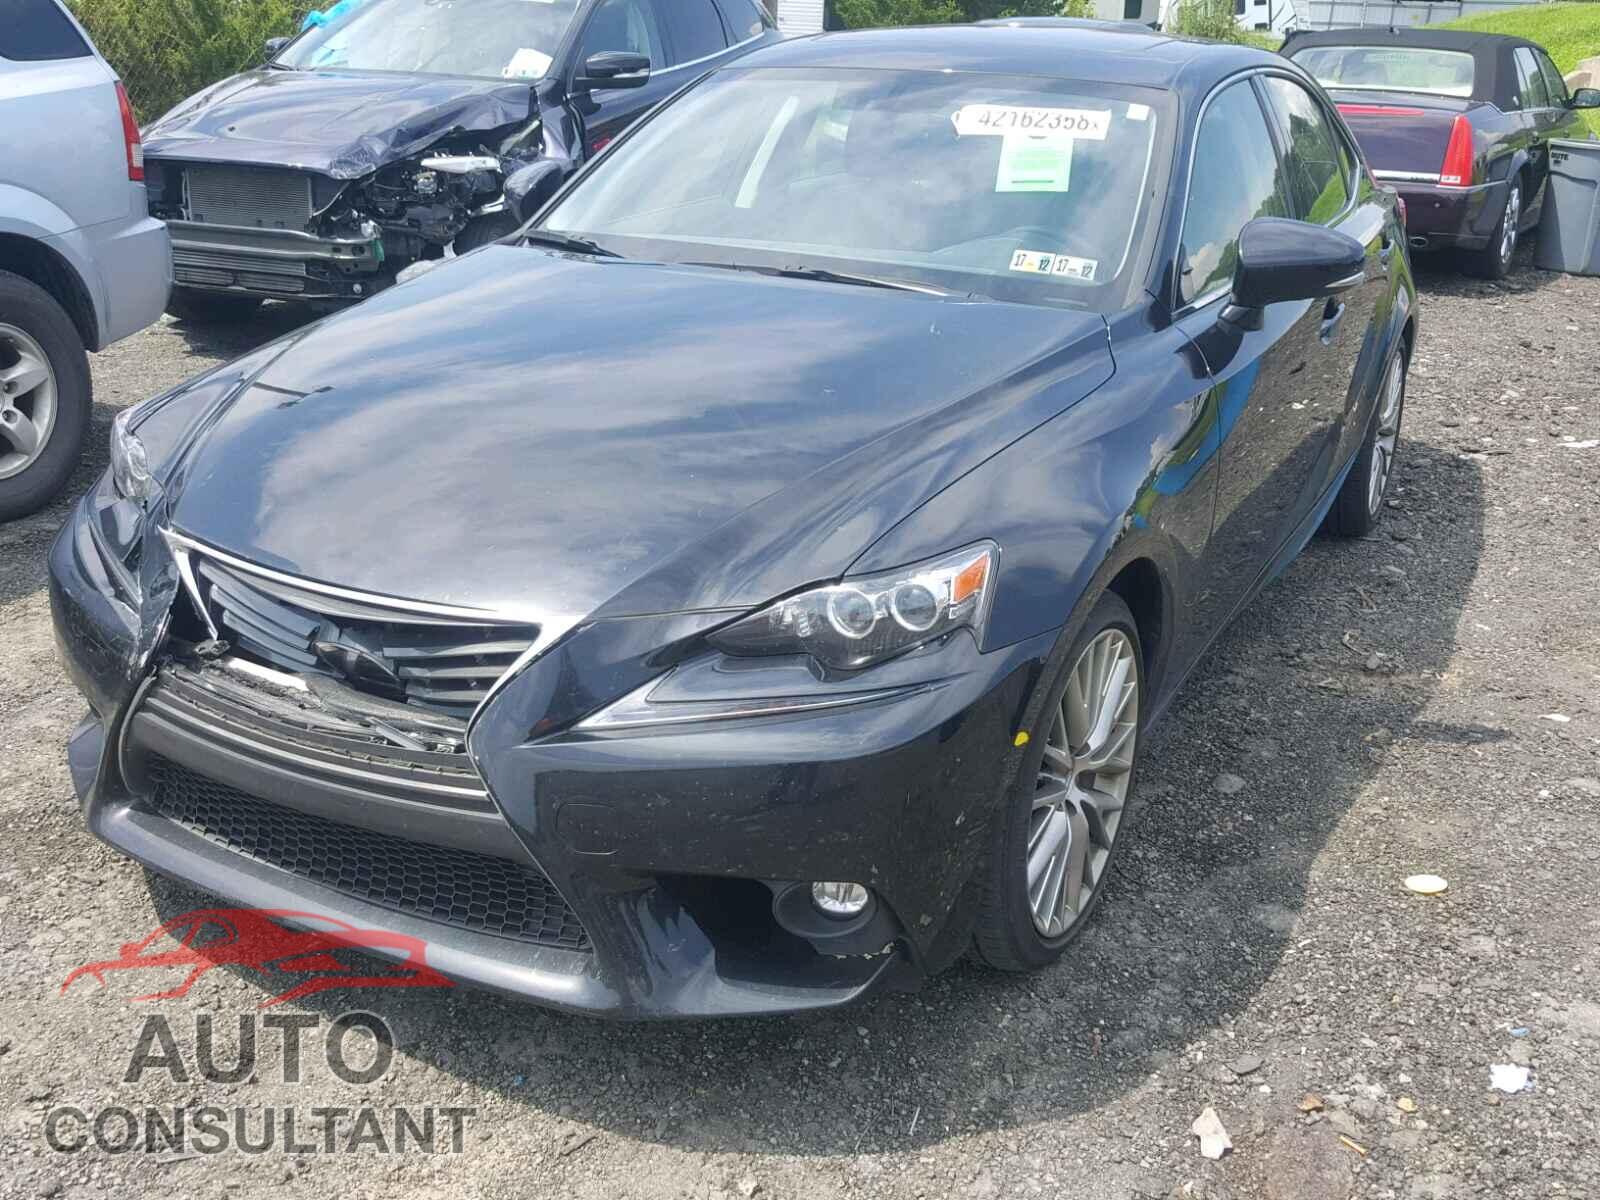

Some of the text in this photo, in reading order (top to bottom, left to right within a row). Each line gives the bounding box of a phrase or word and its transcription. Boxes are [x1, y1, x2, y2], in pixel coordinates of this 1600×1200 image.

[1014, 253, 1051, 272] 17 12
[1055, 258, 1093, 278] 17 12
